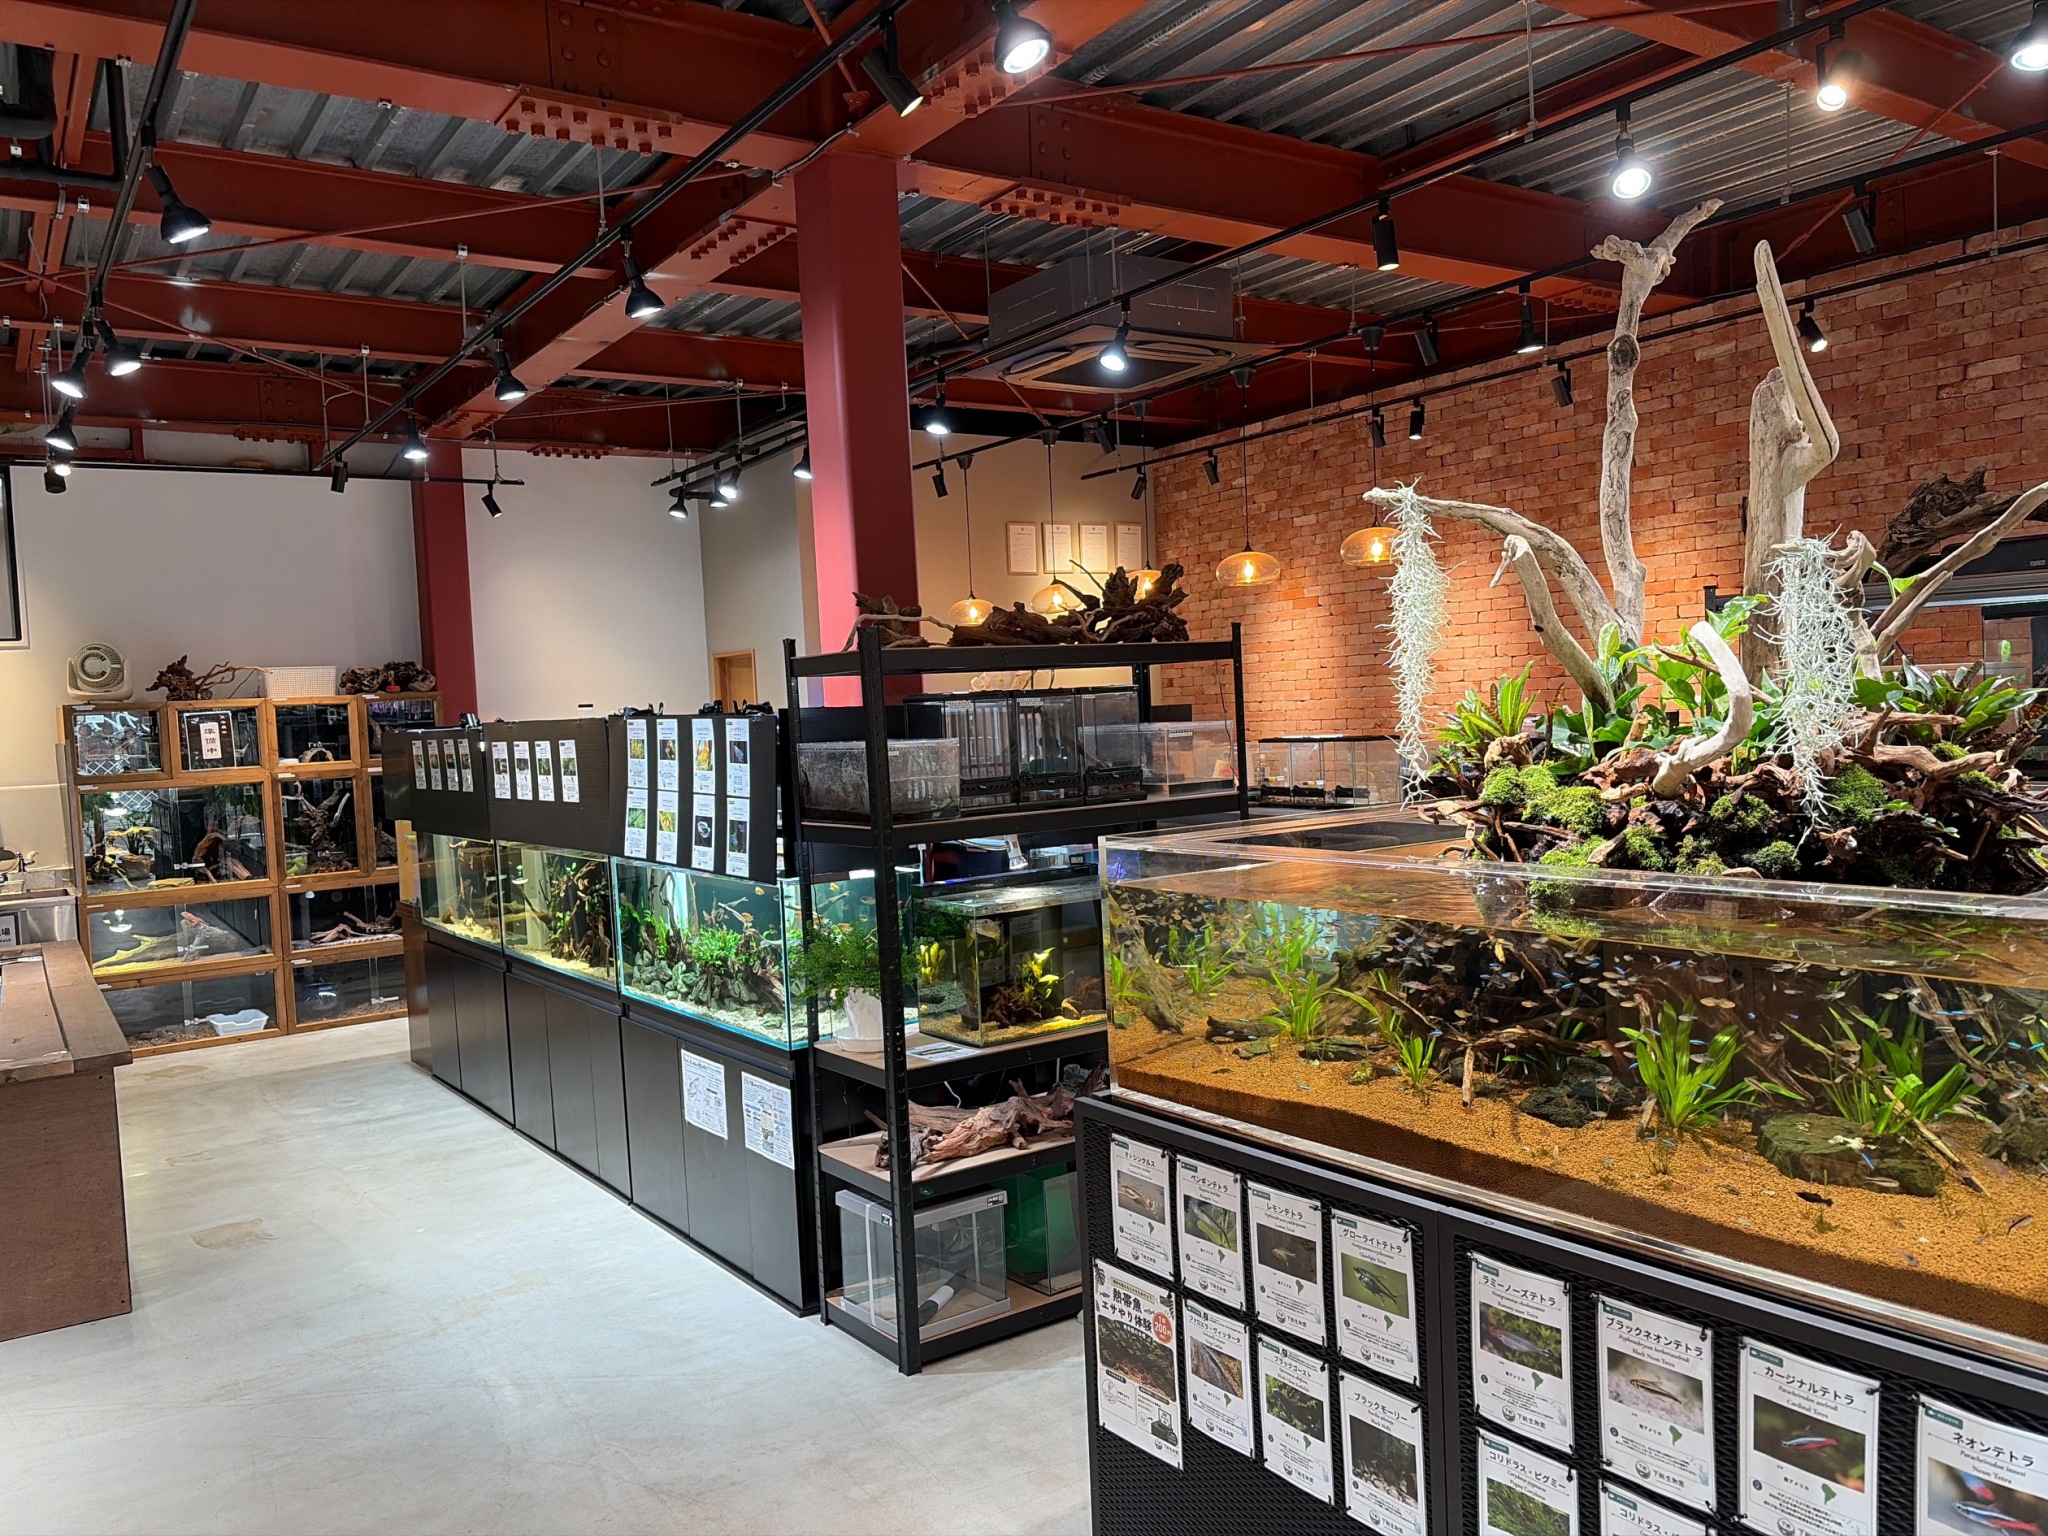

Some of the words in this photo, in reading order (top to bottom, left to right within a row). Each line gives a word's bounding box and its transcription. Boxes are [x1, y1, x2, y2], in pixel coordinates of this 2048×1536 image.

[1190, 1175, 1228, 1192] ペンギンテトラ
[1266, 1202, 1303, 1219] レモンテトラ
[1342, 1228, 1402, 1253] グローライトテトラ
[1112, 1287, 1142, 1314] 熱帯魚
[1482, 1274, 1556, 1307] ラミーノーズテトラ
[1101, 1301, 1153, 1333] エサやり体験
[1154, 1322, 1172, 1337] 200円
[1605, 1315, 1704, 1357] ブラックネオンテトラ
[1273, 1355, 1312, 1379] ブラックゴースト
[1632, 1347, 1645, 1357] Black
[1646, 1352, 1660, 1362] Neon
[1662, 1359, 1675, 1368] Tetra
[1764, 1366, 1855, 1405] カージナルテトラ
[1353, 1392, 1408, 1421] ブラックモーリー
[1786, 1398, 1812, 1413] Cardinal
[1813, 1408, 1829, 1419] Tetra
[1952, 1431, 2034, 1467] ネオンテトラ
[1489, 1450, 1566, 1489] コリドラス・ピグミー
[1971, 1465, 1992, 1478] Neon
[1993, 1471, 2013, 1484] Tetra
